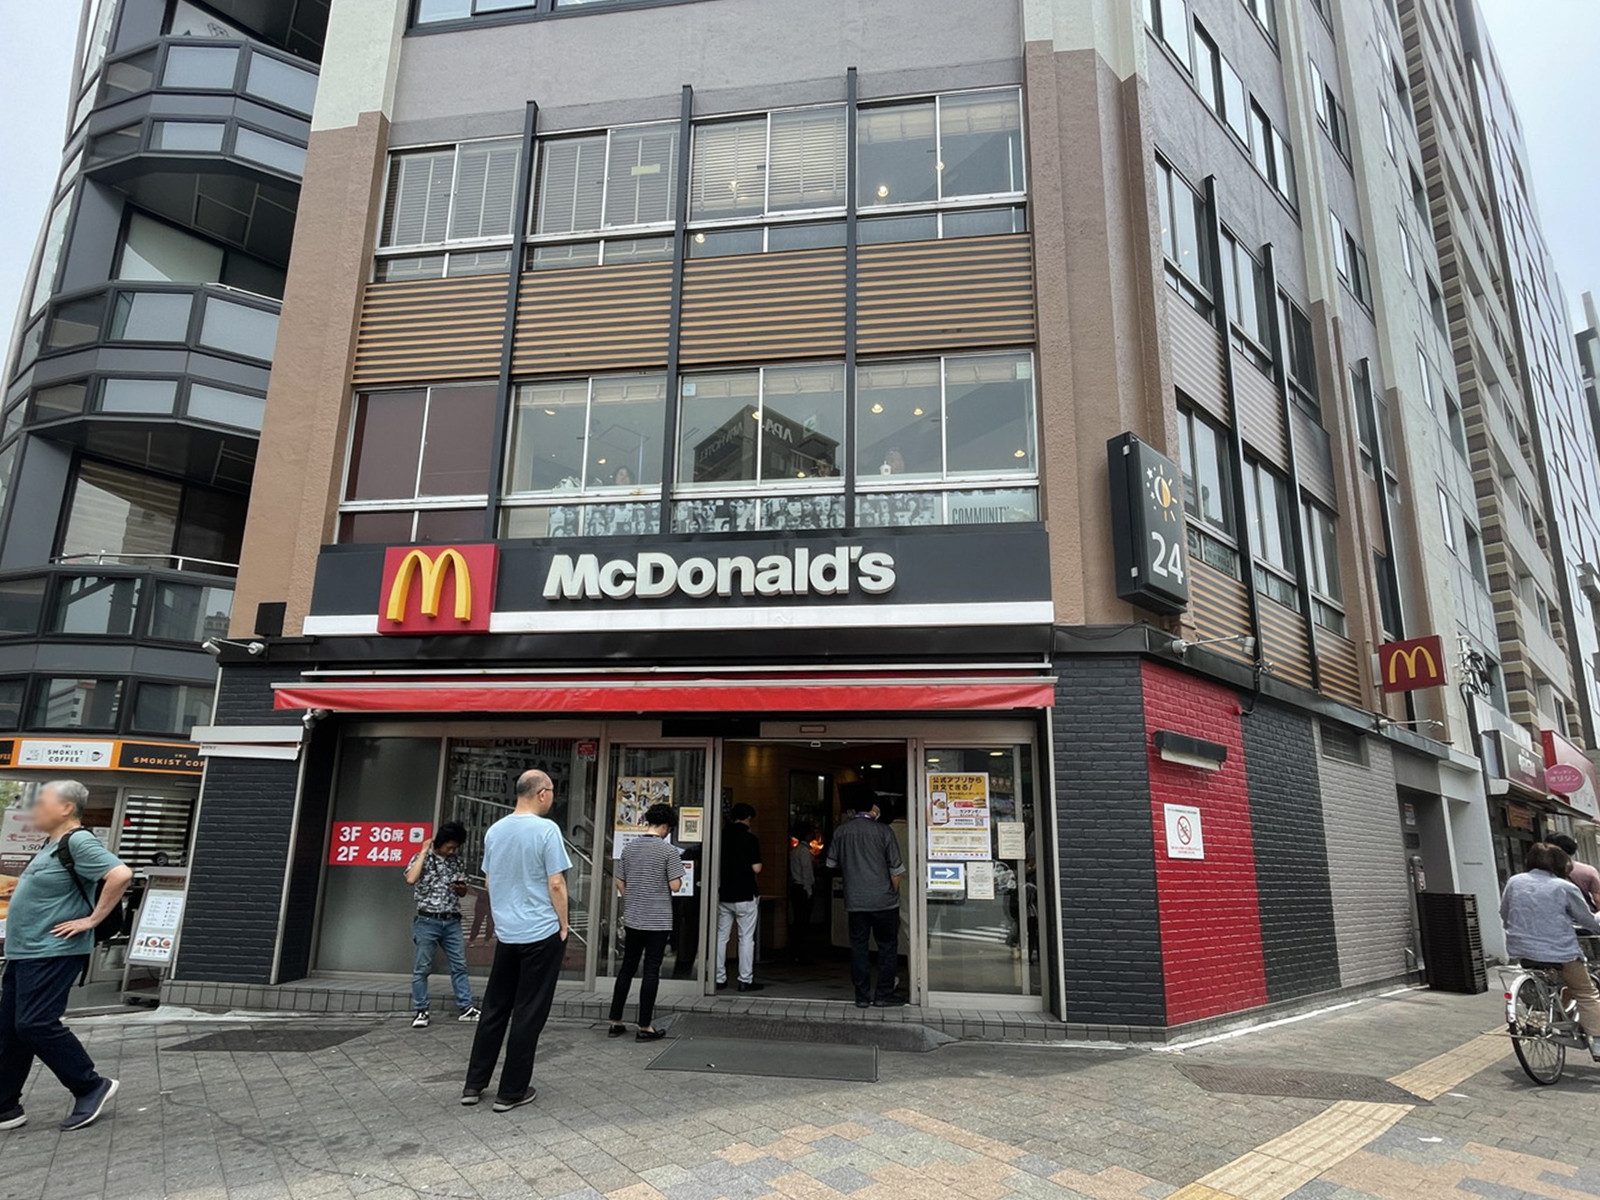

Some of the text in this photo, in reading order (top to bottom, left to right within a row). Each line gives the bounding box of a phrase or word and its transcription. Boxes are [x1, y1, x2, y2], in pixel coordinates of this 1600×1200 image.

[1151, 531, 1184, 585] 24
[542, 546, 897, 599] McDonald's
[133, 756, 181, 766] SMOKIST
[339, 826, 404, 842] 3F 36席
[336, 845, 402, 862] 2F 44席
